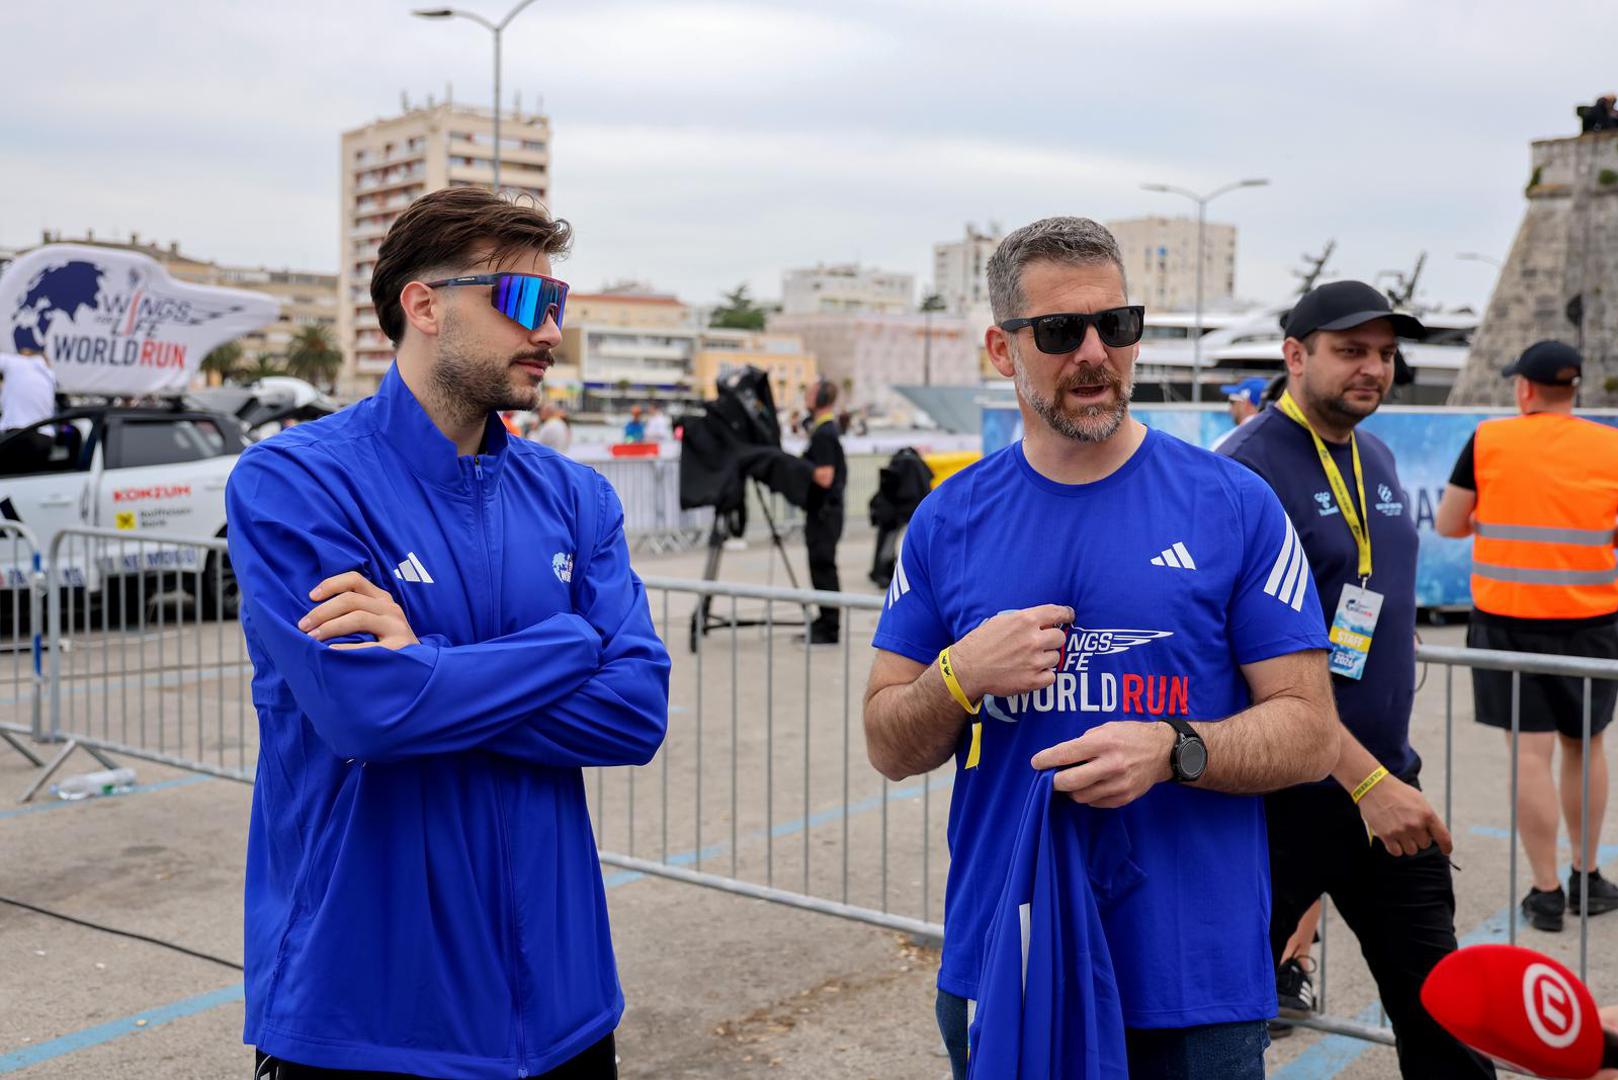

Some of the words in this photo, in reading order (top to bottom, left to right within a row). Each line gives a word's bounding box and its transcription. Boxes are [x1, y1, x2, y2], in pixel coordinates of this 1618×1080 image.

[53, 334, 139, 366] WORLD
[139, 338, 187, 369] RUN
[1121, 673, 1189, 716] RUN
